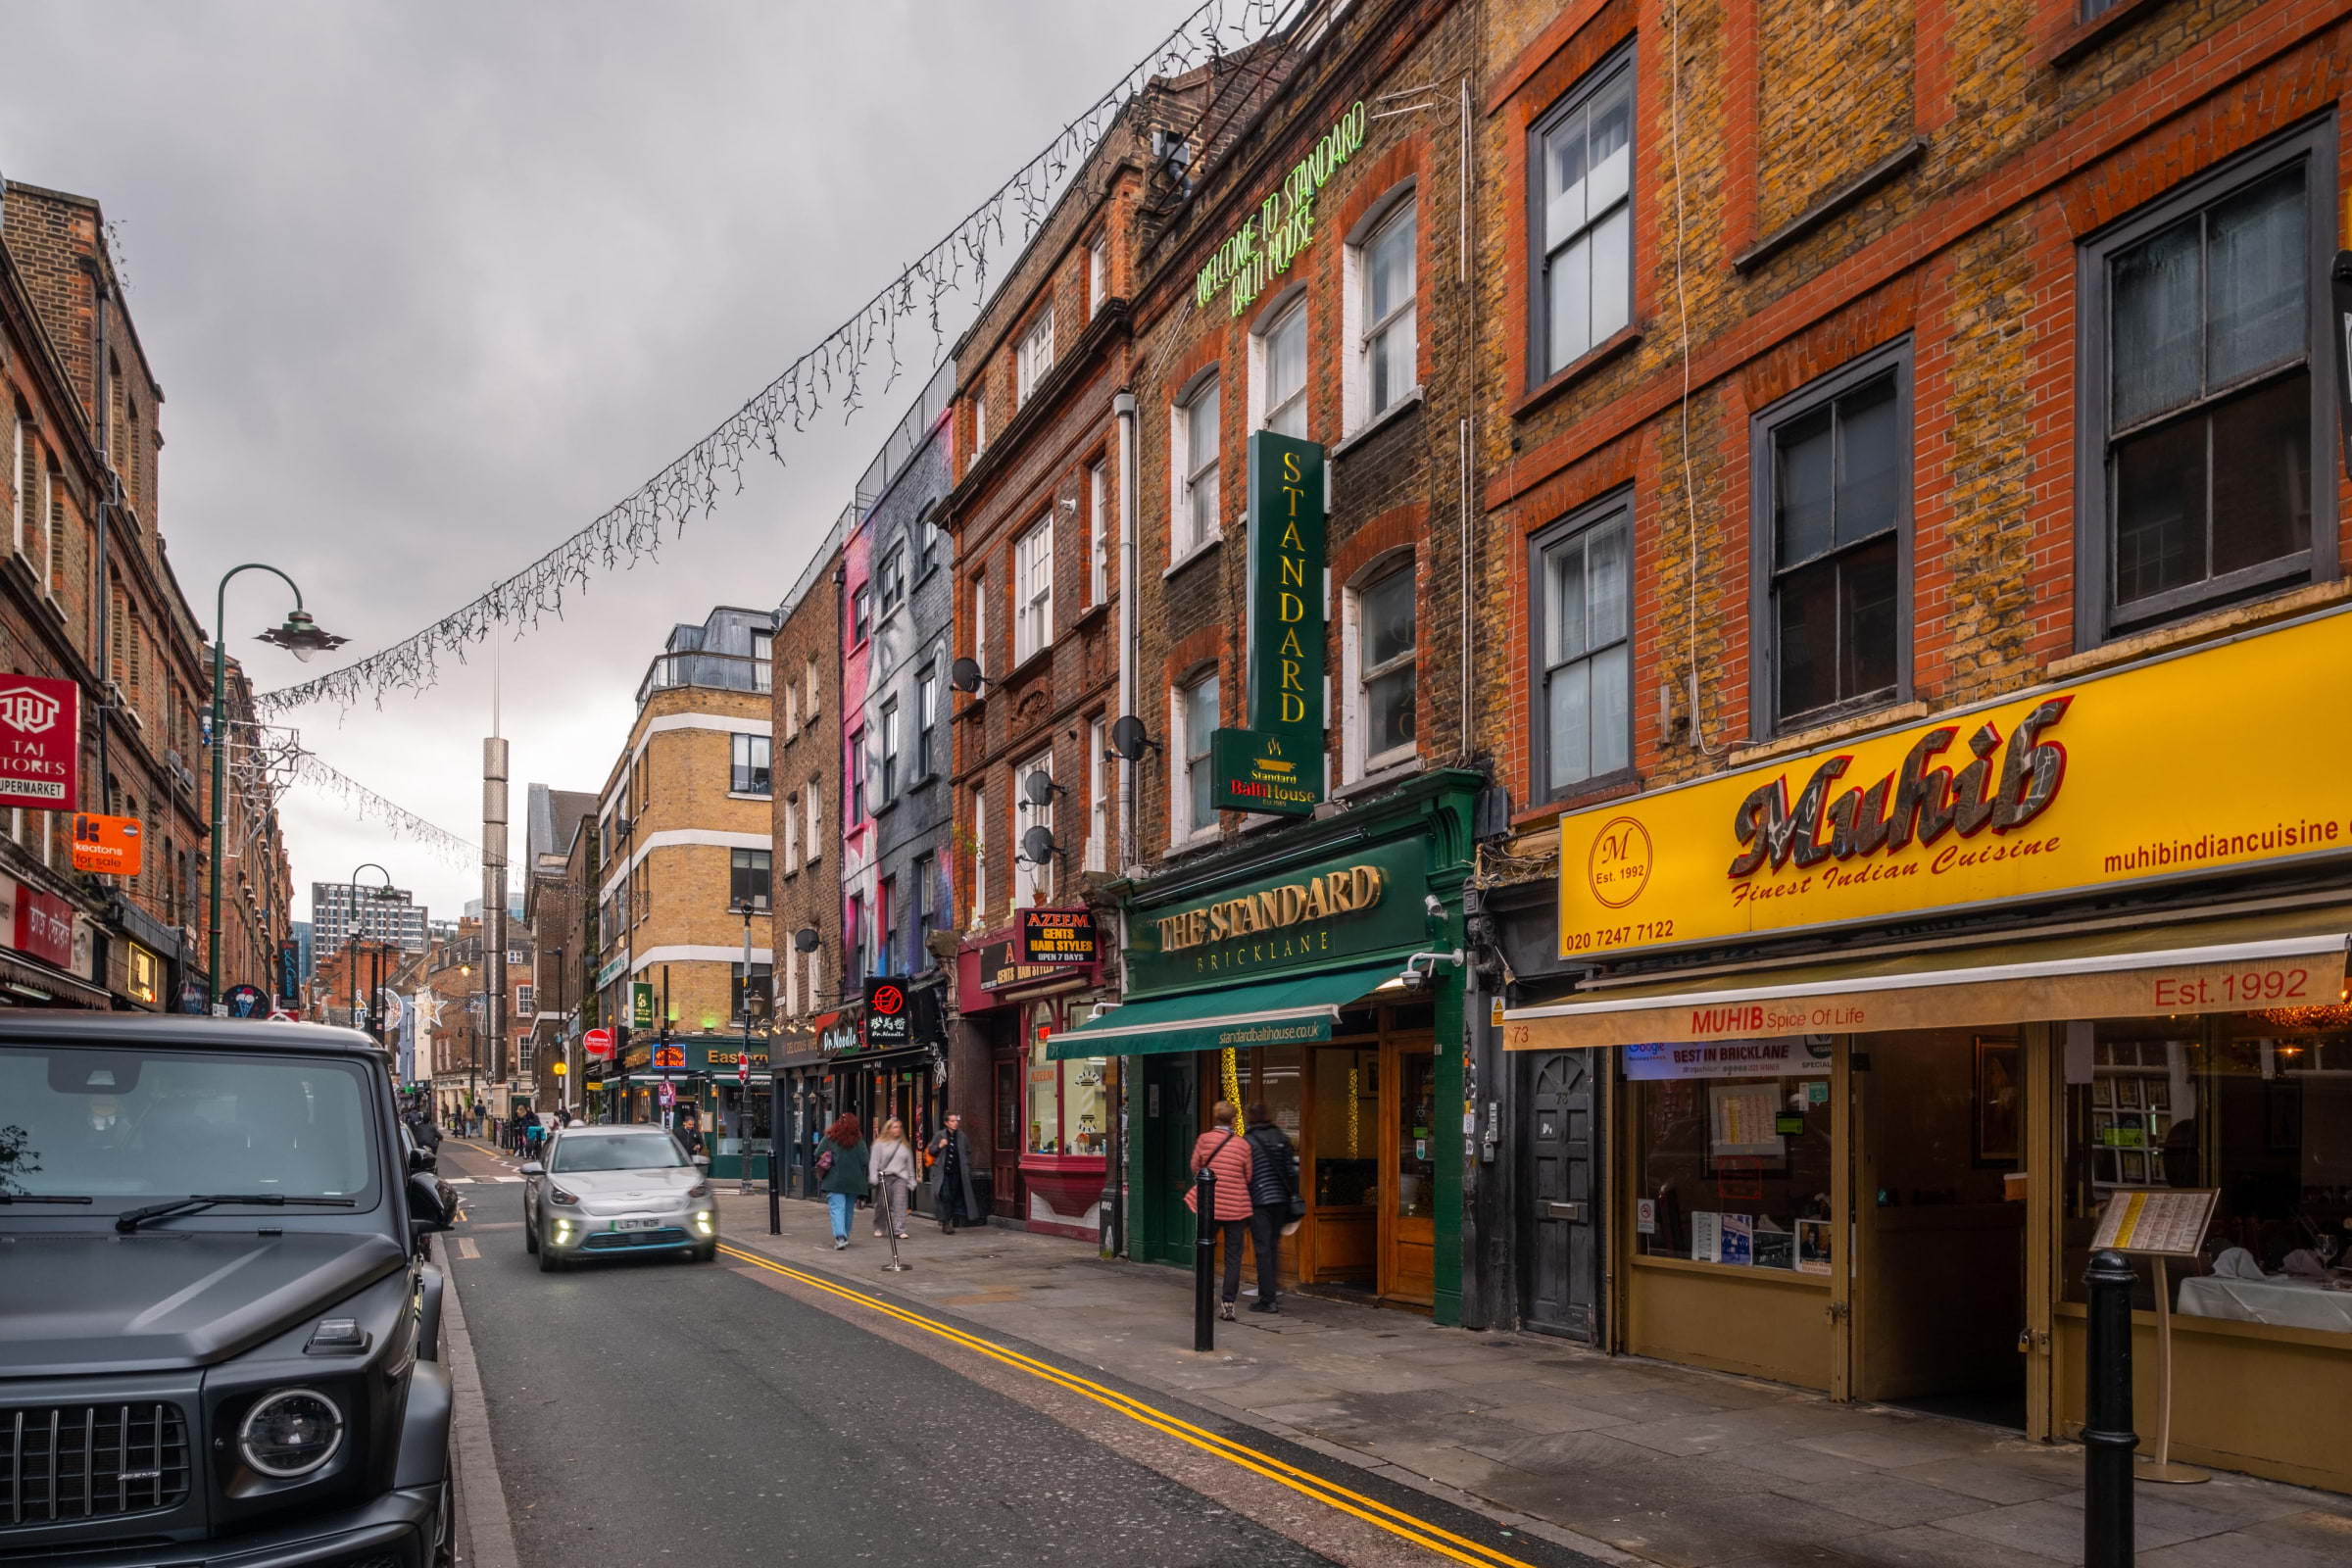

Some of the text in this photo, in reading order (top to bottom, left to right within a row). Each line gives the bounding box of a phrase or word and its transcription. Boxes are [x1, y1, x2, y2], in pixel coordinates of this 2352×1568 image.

[1197, 100, 1364, 307] WELCOME TO STANDARD
[1231, 198, 1314, 317] BALTI HOUSE
[1278, 452, 1306, 723] STANDARD
[11, 740, 44, 758] TAJ
[1250, 769, 1297, 784] Standard
[1728, 695, 2076, 879] Muhib
[75, 842, 123, 856] keatons
[1601, 827, 1634, 864] M
[2104, 819, 2338, 873] muhibindiancuisine
[76, 854, 92, 863] for
[96, 858, 122, 867] sale
[1731, 836, 2061, 907] Finest Indian Cuisine
[1595, 864, 1644, 884] Est. 1992
[1027, 912, 1090, 927] AZEEM
[1157, 865, 1383, 953] THE STANDARD
[1043, 928, 1075, 940] GENTS
[1566, 919, 1674, 951] 020 7247 7122
[1030, 940, 1093, 952] HAIR STYLES
[997, 967, 1014, 985] GENTS
[1017, 964, 1031, 979] HAIR
[2155, 968, 2308, 1006] Est. 1992
[1691, 1005, 1865, 1035] MUHIB Spice Of Life
[1219, 1021, 1319, 1044] standardbaltihouse.co.uk
[1512, 1025, 1530, 1044] 73
[1673, 1045, 1789, 1063] BEST IN BRICKLANE
[1031, 1069, 1054, 1083] AZEEM
